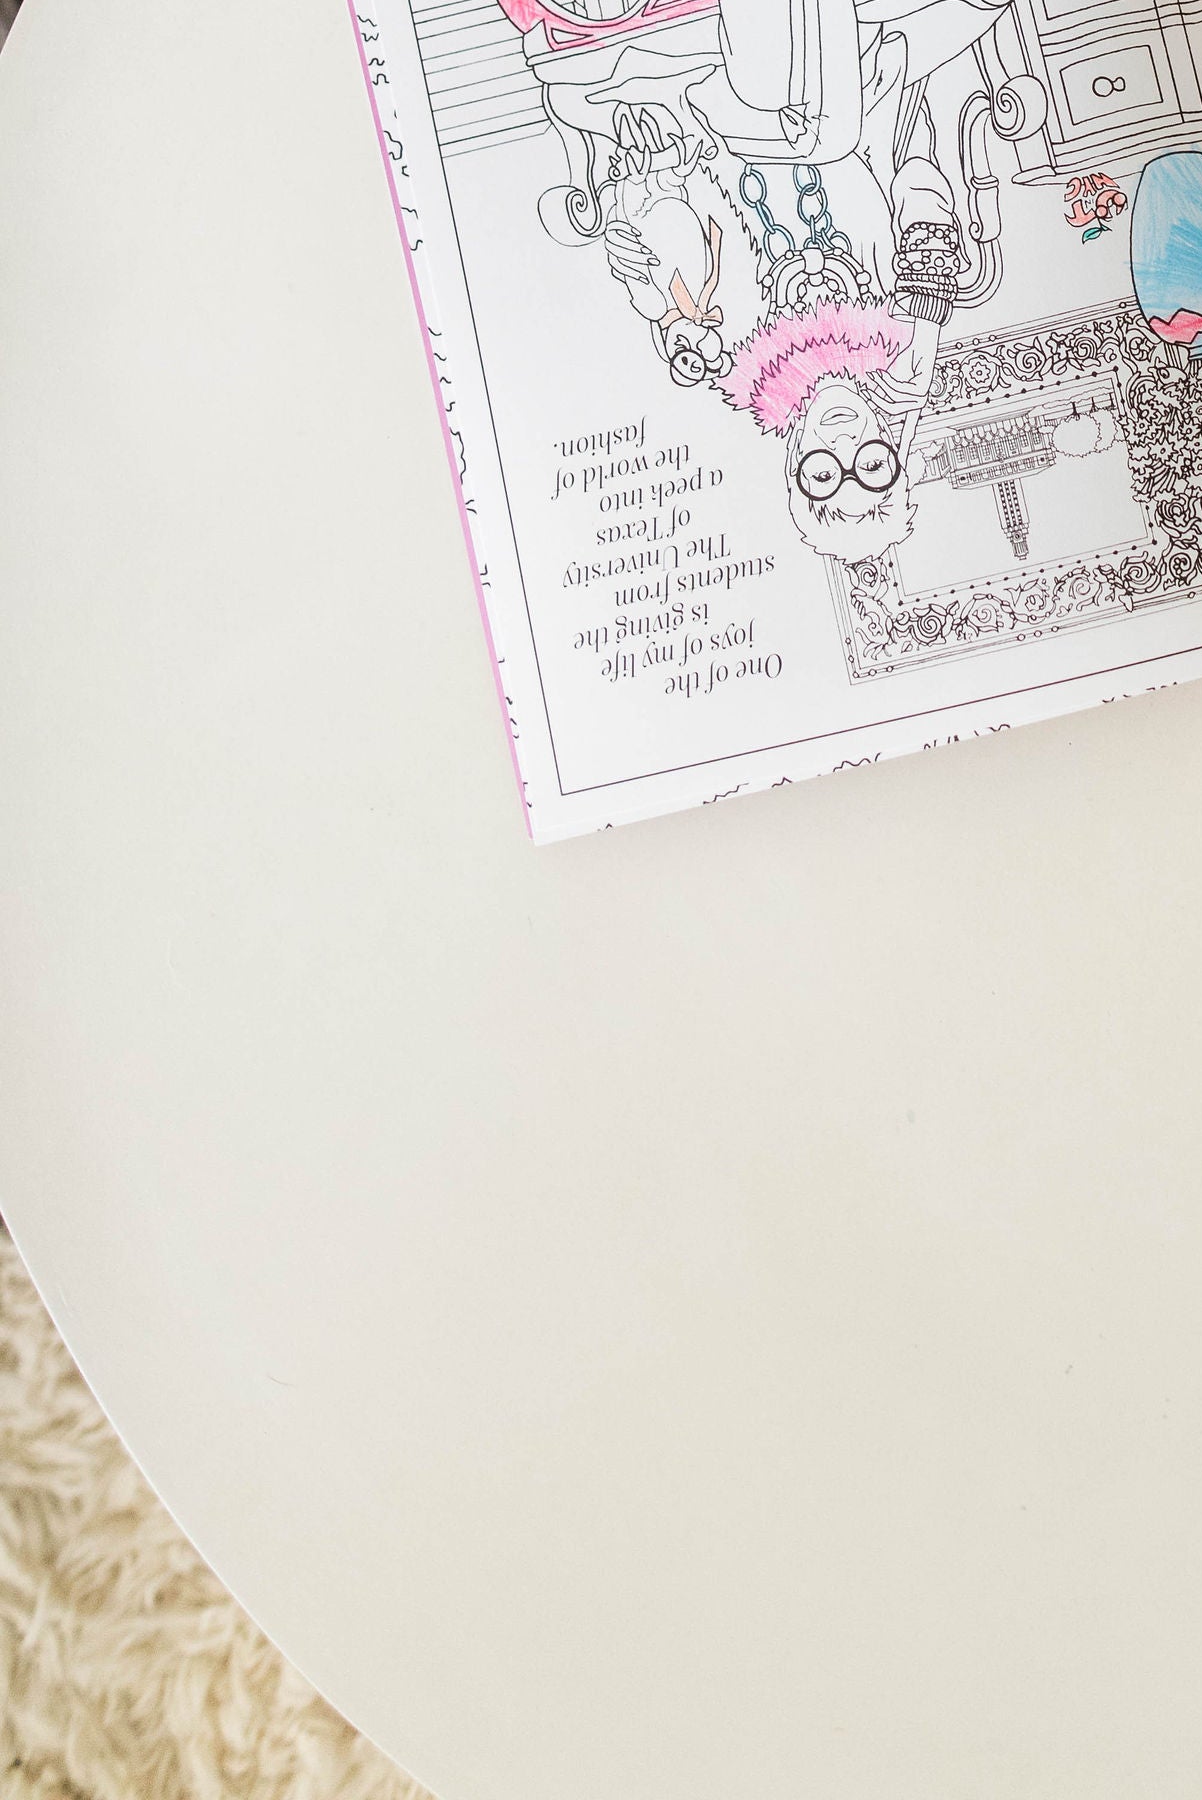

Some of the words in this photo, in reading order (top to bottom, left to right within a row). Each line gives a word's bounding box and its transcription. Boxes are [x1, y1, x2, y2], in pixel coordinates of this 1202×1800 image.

[553, 415, 647, 457] fashion.
[583, 455, 649, 493] world
[655, 444, 690, 471] the
[551, 467, 575, 501] of
[651, 466, 702, 507] peek
[708, 468, 724, 486] a
[599, 489, 643, 513] into
[596, 517, 664, 546] Texas
[666, 505, 691, 538] of
[686, 533, 732, 562] The
[561, 544, 680, 589] University
[677, 554, 776, 590] students
[614, 571, 670, 607] from
[615, 602, 684, 644] giving
[691, 603, 709, 626] is
[573, 626, 609, 653] the
[710, 616, 756, 648] joys
[601, 649, 635, 683] life
[642, 641, 674, 668] my
[679, 632, 703, 667] of
[735, 653, 783, 679] One
[665, 671, 699, 698] the
[705, 659, 729, 694] of
